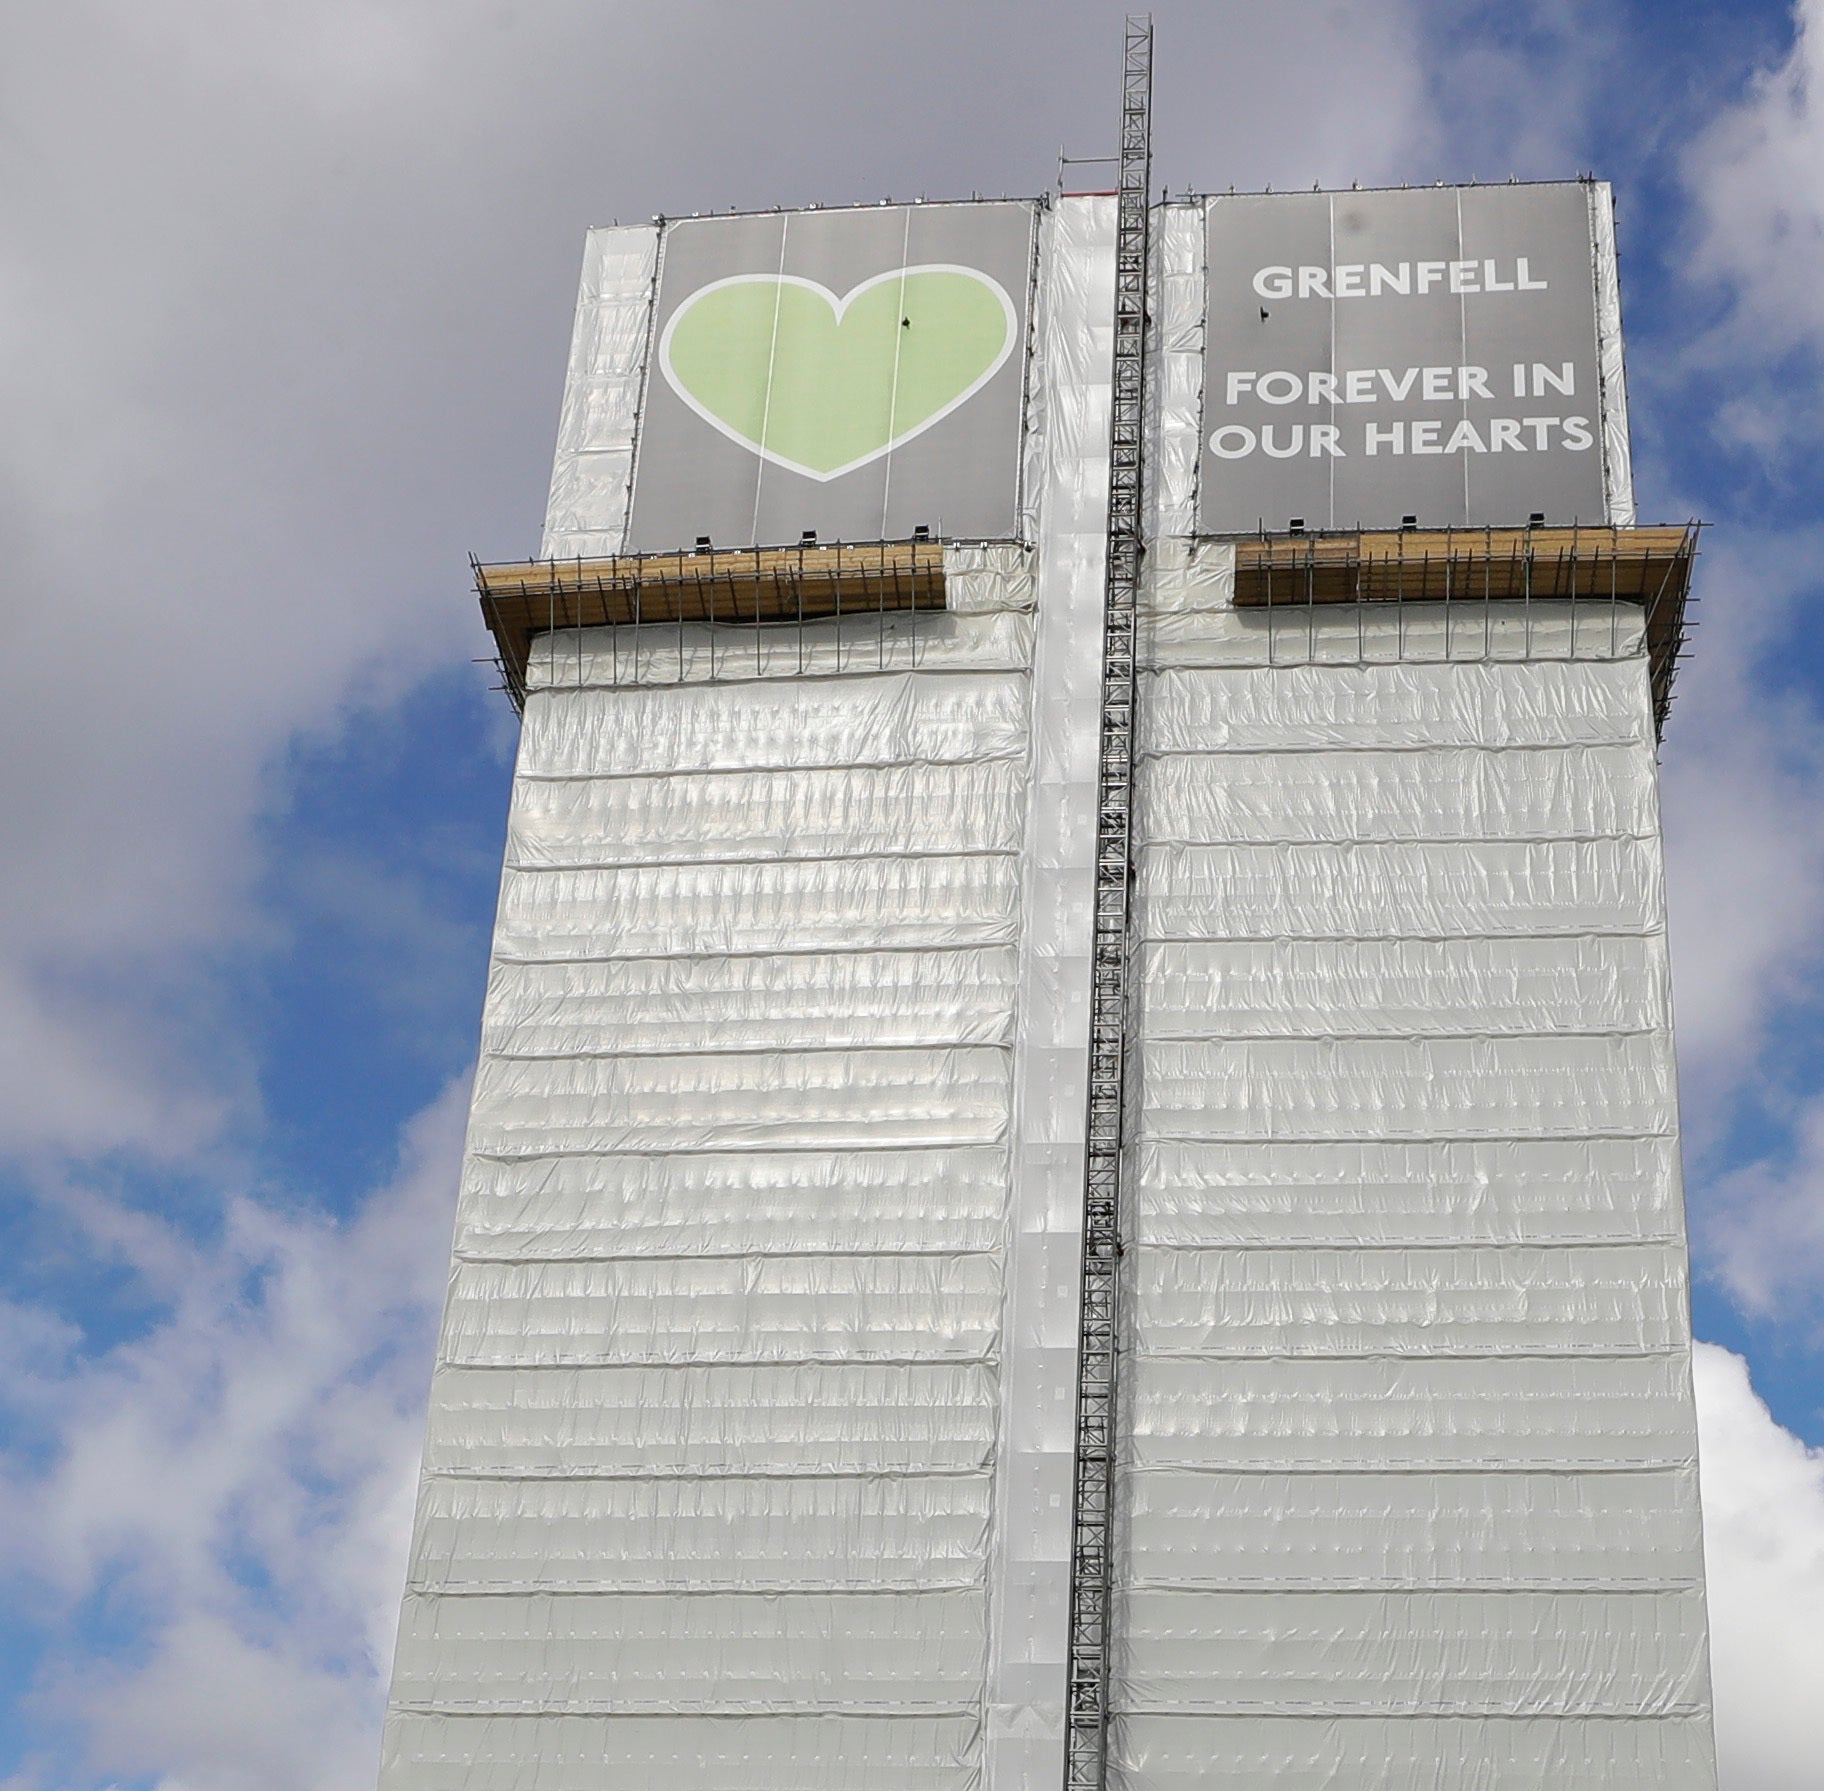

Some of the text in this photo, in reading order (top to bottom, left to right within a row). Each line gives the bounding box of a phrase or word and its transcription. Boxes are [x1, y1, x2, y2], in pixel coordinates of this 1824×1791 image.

[1252, 257, 1549, 300] GRENFELL
[1225, 362, 1576, 405] FOREVER IN
[1208, 415, 1595, 459] OUR HEARTS
